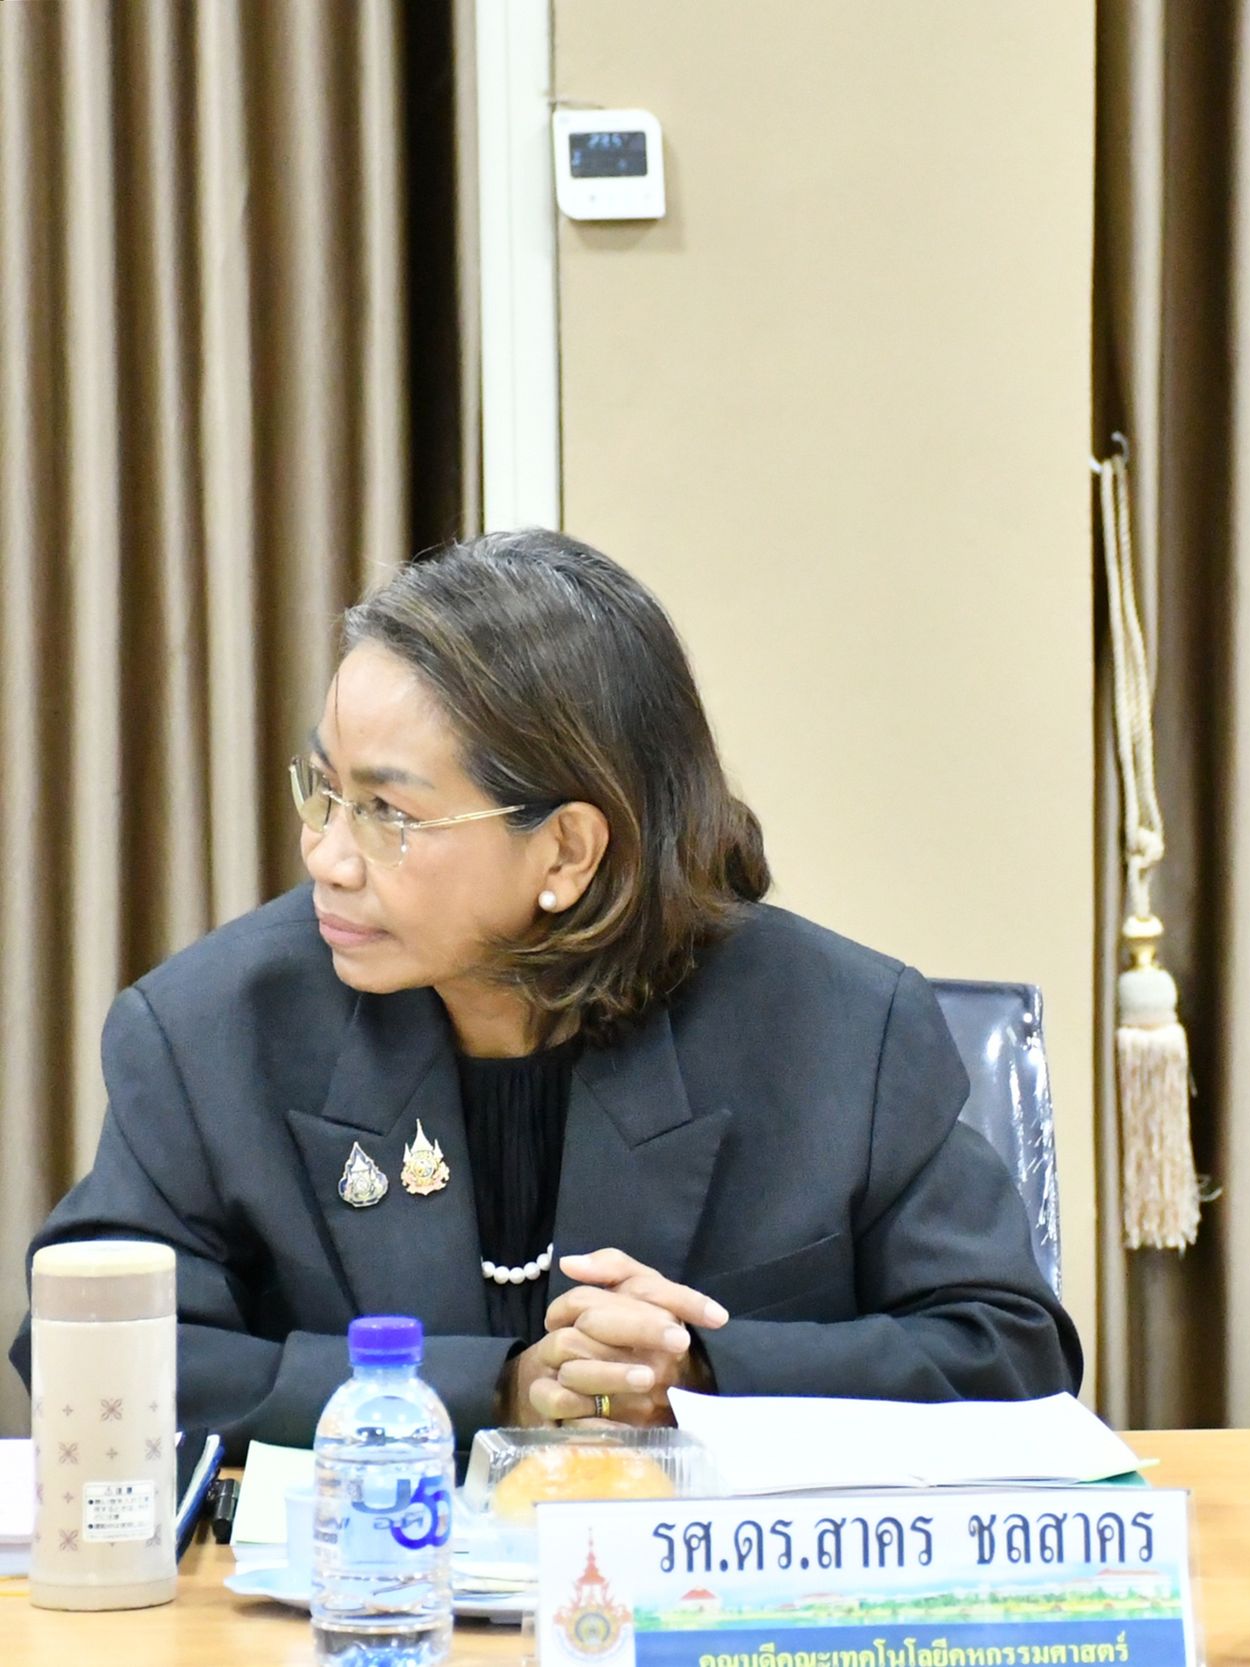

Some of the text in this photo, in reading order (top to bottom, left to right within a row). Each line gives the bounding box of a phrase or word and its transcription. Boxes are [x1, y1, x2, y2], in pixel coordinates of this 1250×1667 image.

[652, 1511, 1154, 1573] รศ.ดร.สาคร ชลสาคร
